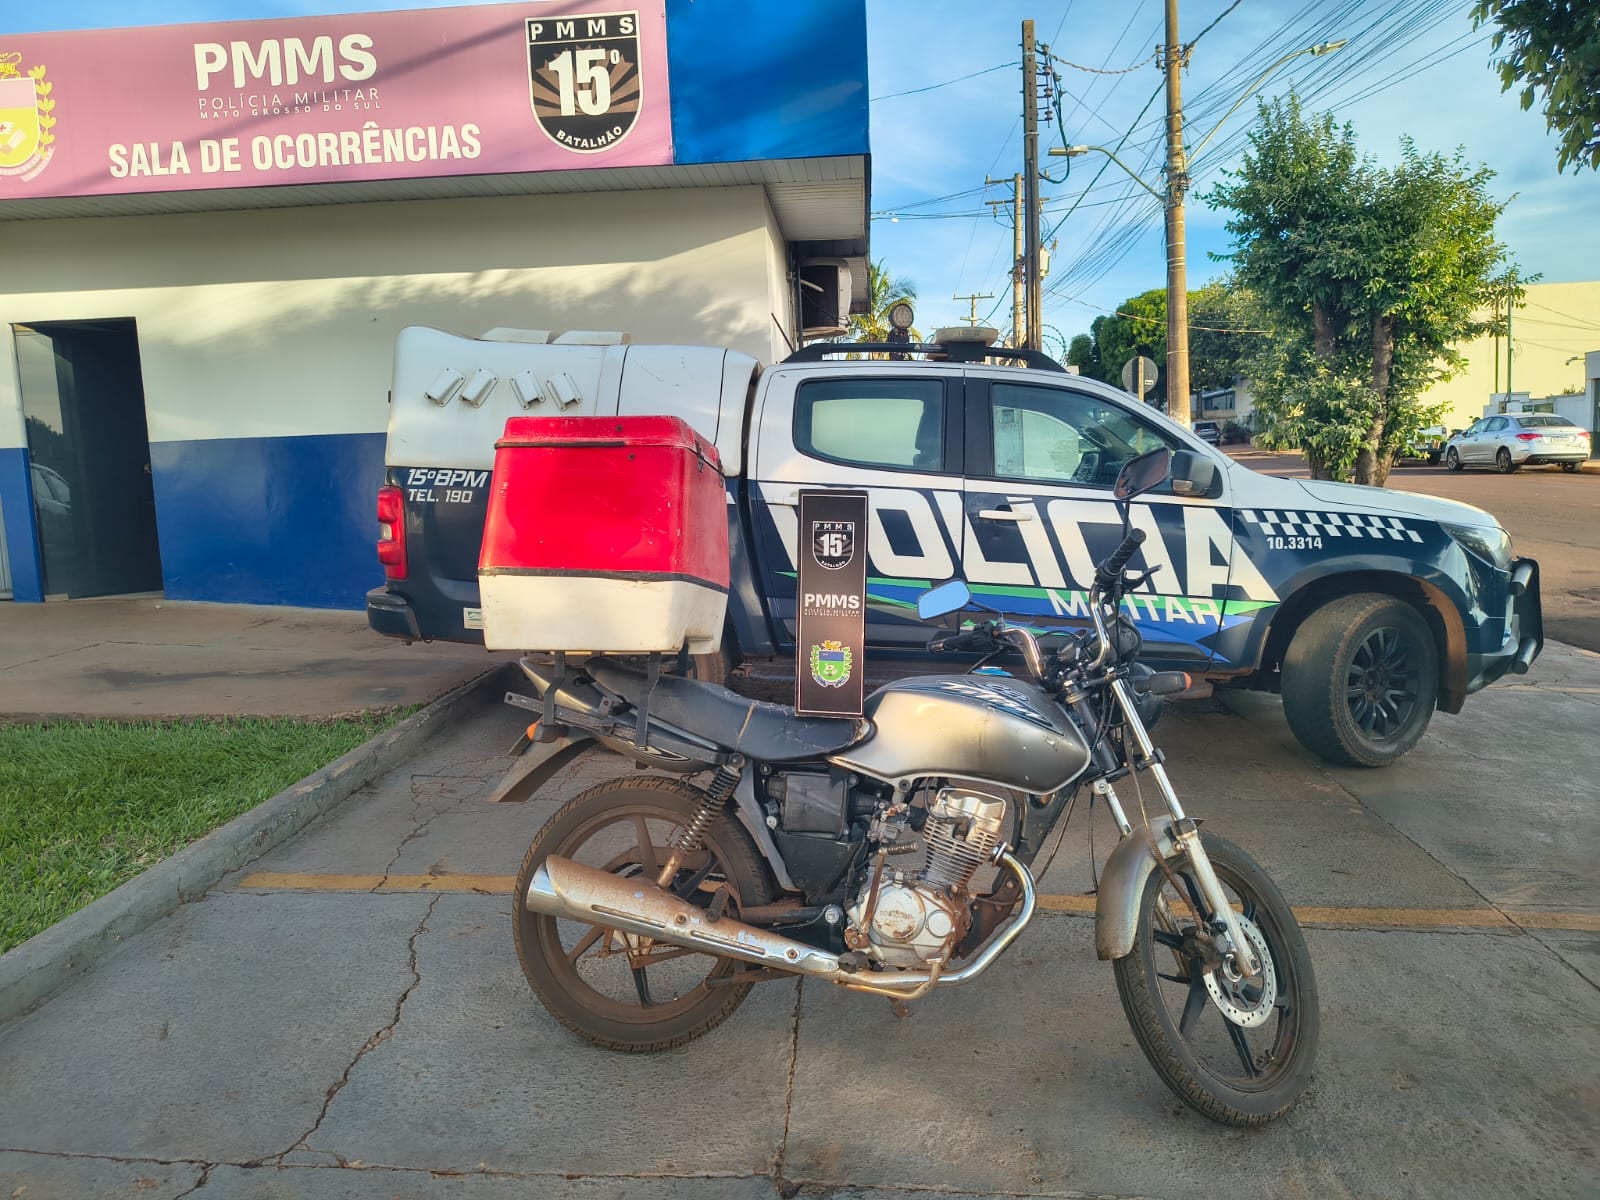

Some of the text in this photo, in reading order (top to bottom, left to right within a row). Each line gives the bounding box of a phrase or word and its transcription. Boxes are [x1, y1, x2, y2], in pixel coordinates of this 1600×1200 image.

[530, 16, 634, 41] PMMS
[194, 33, 377, 91] PMMS
[199, 88, 379, 110] POLÍCIA MILITAR
[200, 101, 381, 119] MATO GROSSO DO SUL
[556, 125, 622, 148] BATALHÃO
[108, 120, 481, 178] SALA DE OCORRÊNCIAS
[445, 489, 473, 503] 190
[814, 523, 853, 531] PMMS
[1266, 536, 1323, 550] 10.3314
[804, 593, 860, 609] PMMS
[1046, 588, 1225, 627] MITAR
